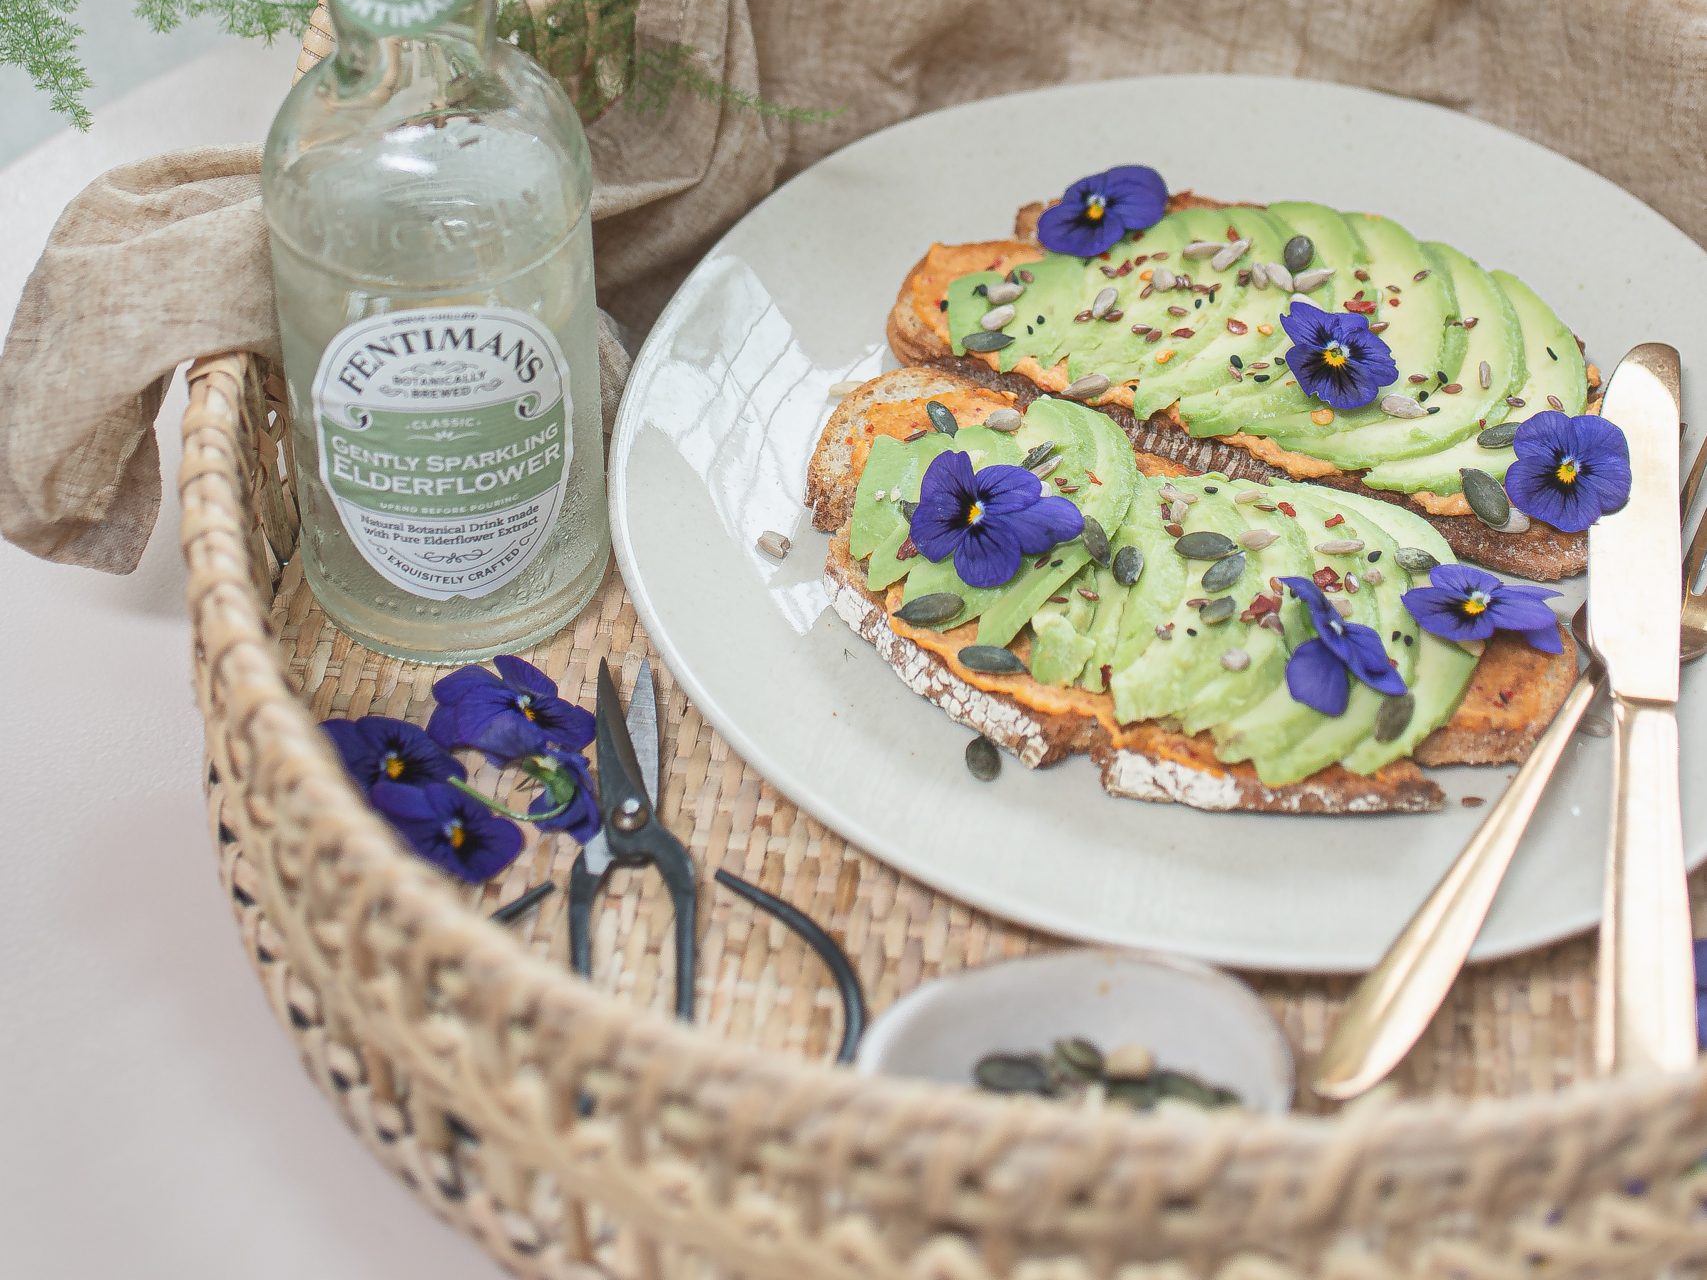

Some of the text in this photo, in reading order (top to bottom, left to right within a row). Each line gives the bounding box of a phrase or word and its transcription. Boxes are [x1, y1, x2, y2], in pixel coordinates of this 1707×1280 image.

[339, 327, 544, 396] FENTIMANS
[392, 368, 487, 386] BOTANICALLY
[411, 386, 471, 399] BREWED
[411, 417, 475, 431] CLASSIC
[331, 422, 559, 472] GENTLY SPARKLING
[333, 442, 562, 497] ELDERFLOWER
[421, 505, 467, 515] BEFORE
[470, 493, 520, 512] POURING
[360, 504, 540, 535] Natural Botanical Drink made
[363, 516, 539, 546] with Pure Elderflower Extract
[387, 548, 520, 585] EXQUISITELY CRAFTED
